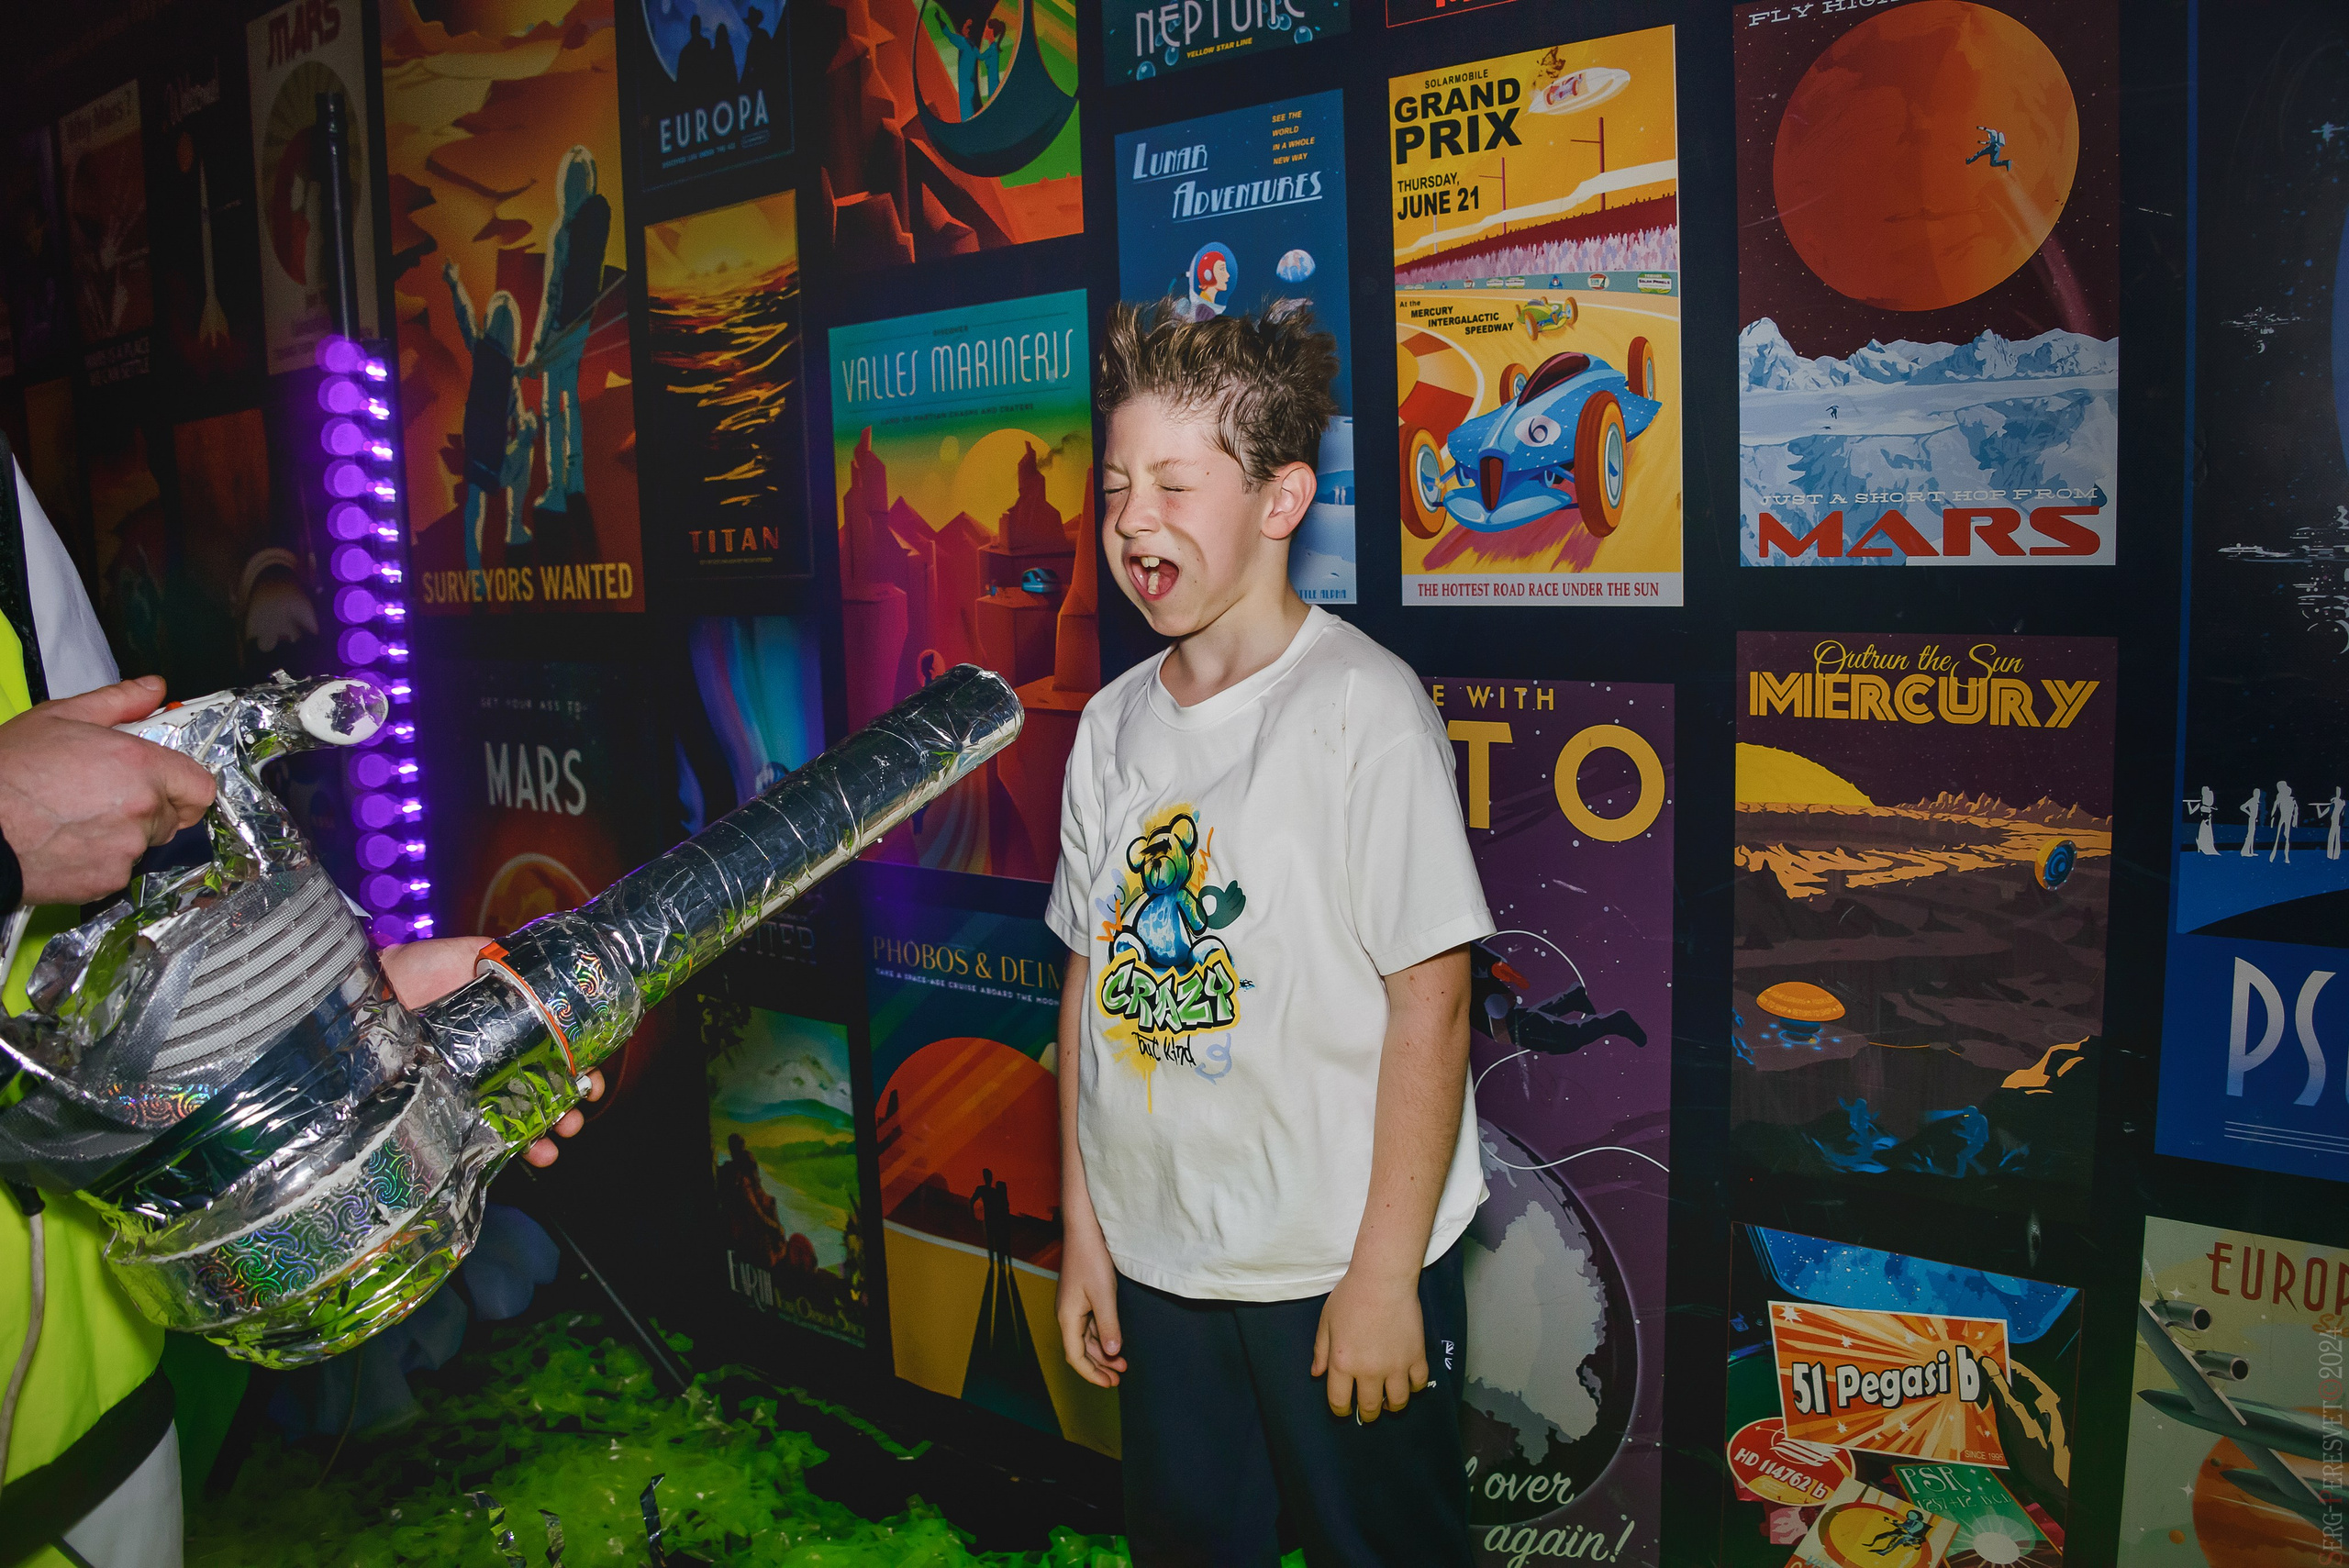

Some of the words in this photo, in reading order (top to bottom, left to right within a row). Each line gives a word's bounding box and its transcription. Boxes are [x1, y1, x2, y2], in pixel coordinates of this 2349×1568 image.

[1748, 3, 1814, 27] FLY
[1186, 44, 1215, 59] YELLOW
[1216, 41, 1235, 52] STAR
[1236, 38, 1252, 48] LINE
[1424, 69, 1488, 89] SOLARMOBILE
[1394, 77, 1520, 123] GRAND
[660, 88, 769, 154] EUROPA
[1272, 114, 1286, 123] SEE
[1288, 110, 1302, 119] THE
[1272, 126, 1299, 137] WORLD
[1273, 143, 1280, 151] IN
[1288, 137, 1315, 148] WHOLE
[1395, 107, 1522, 164] PRIX
[1274, 155, 1290, 164] NEW
[1292, 153, 1308, 162] WAY
[1397, 172, 1460, 193] THURSDAY,
[1397, 190, 1451, 220] JUNE
[1457, 186, 1479, 212] 21
[1411, 306, 1453, 317] MERCURY
[1428, 312, 1499, 328] INTERGALACTIC
[1464, 322, 1514, 335] SPEEDWAY
[842, 350, 918, 402] VALLES
[931, 328, 1073, 393] MARINERIS
[1529, 418, 1548, 443] 6
[1760, 494, 1823, 506] JUST
[1829, 494, 1847, 505] A
[1854, 491, 1946, 504] SHORT
[1952, 489, 2006, 502] HOP
[2013, 487, 2099, 500] FROM
[688, 526, 780, 553] TITAN
[1759, 506, 2100, 558] MARS
[422, 566, 535, 604] SURVEYORS
[540, 562, 633, 600] WANTED
[1298, 589, 1316, 599] TTLE
[1418, 583, 1439, 596] THE
[1442, 583, 1489, 597] HOTTEST
[1493, 583, 1525, 596] ROAD
[1528, 583, 1558, 596] RACE
[1562, 583, 1603, 597] UNDER
[1606, 582, 1631, 596] THE
[1633, 582, 1659, 596] SUN
[1813, 639, 1909, 680] Outrun
[1917, 644, 1953, 673] the
[1951, 643, 2024, 687] Sun
[1432, 684, 1444, 706] E
[1466, 685, 1554, 711] WITH
[1749, 671, 2100, 728] MERCURY
[484, 741, 586, 816] MARS
[873, 935, 969, 975] PHOBOS
[975, 952, 992, 979] &
[948, 981, 976, 993] CRUISE
[980, 986, 1013, 999] ABOARD
[1016, 992, 1032, 1003] THE
[1102, 958, 1234, 1035] CRAZY
[2226, 956, 2349, 1106] PS
[1792, 1362, 1831, 1416] 51
[1836, 1349, 1950, 1408] Pegasi
[1955, 1345, 1981, 1402] b
[1965, 1450, 1984, 1461] SINCE
[1986, 1452, 2004, 1462] 1995
[1733, 1448, 1759, 1468] HD
[1758, 1456, 1813, 1493] 114762
[1813, 1484, 1828, 1500] b
[1899, 1466, 1971, 1495] PSR
[1484, 1472, 1575, 1505] over
[1484, 1520, 1634, 1568] again!
